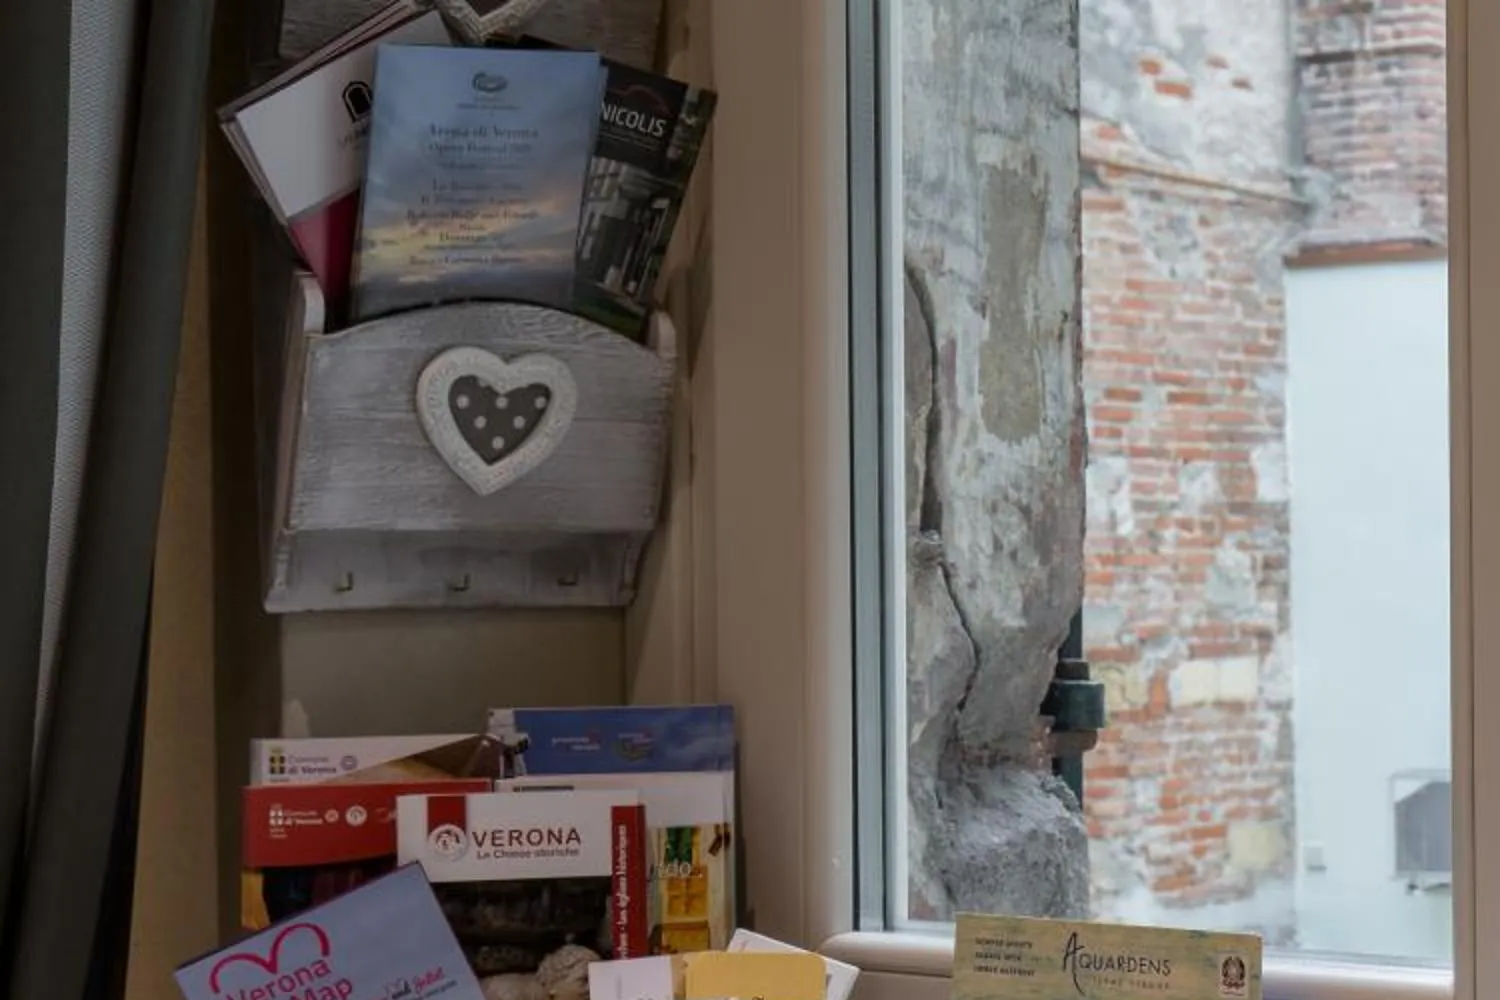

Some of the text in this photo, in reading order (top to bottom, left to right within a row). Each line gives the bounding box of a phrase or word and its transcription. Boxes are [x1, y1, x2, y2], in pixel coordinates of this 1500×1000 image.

[601, 100, 667, 137] NICOLIS
[471, 826, 582, 849] VERONA
[1062, 931, 1173, 996] AQUARDENS
